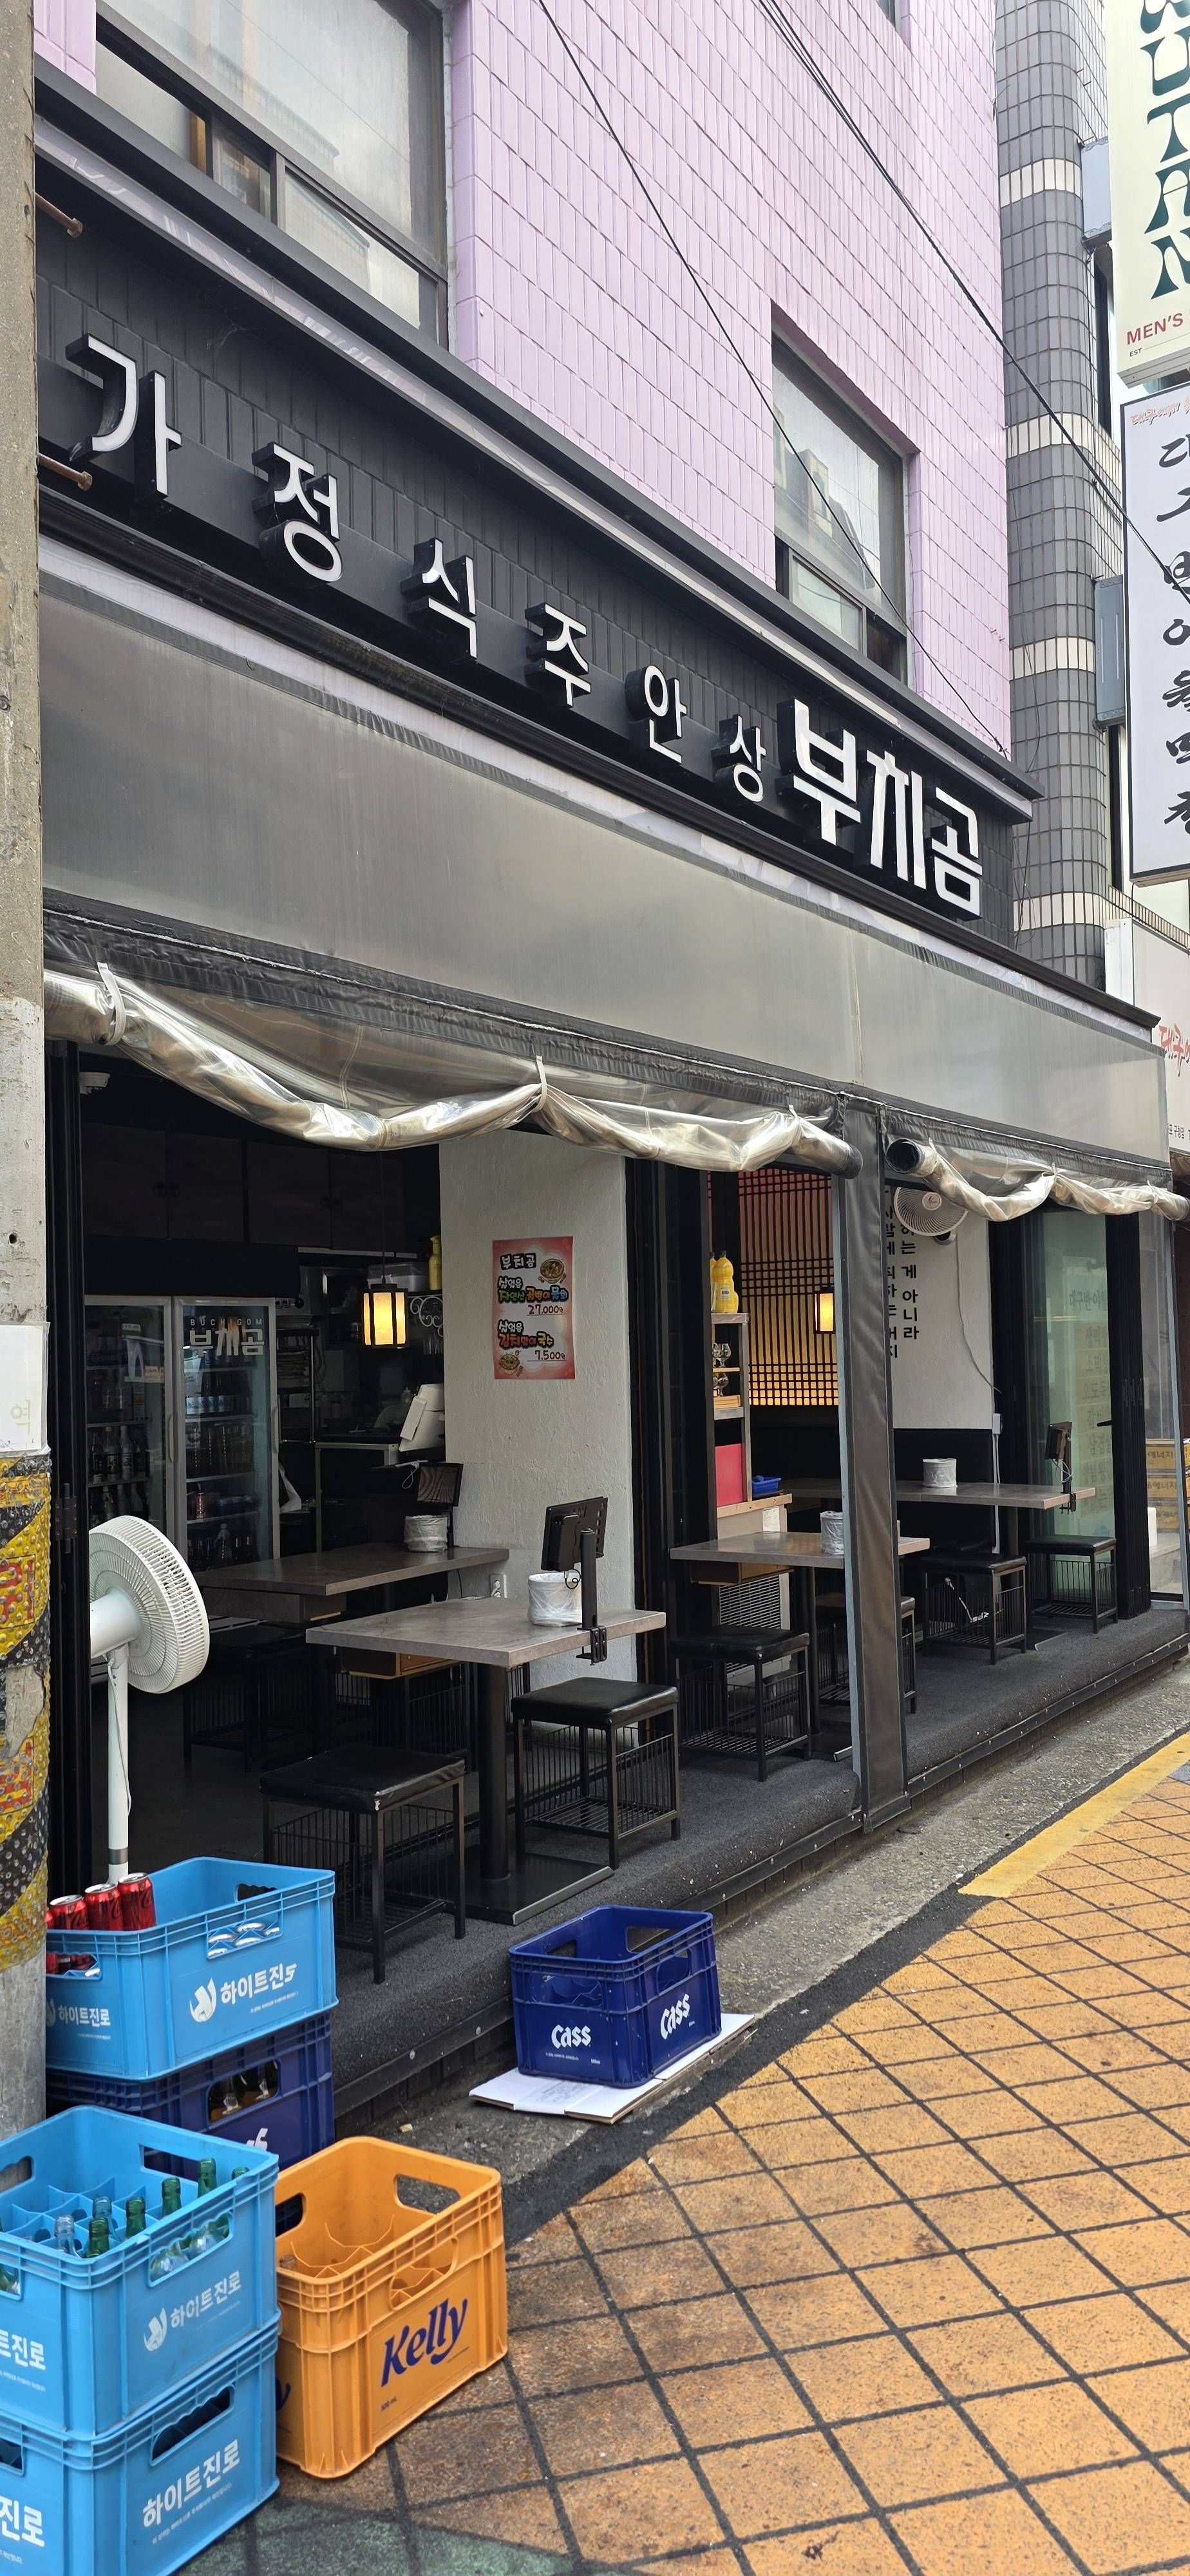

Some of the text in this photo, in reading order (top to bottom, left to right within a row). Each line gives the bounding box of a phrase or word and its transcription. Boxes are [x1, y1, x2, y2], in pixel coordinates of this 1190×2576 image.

[1127, 313, 1184, 345] MEN'S
[1129, 348, 1142, 357] EST
[190, 1318, 263, 1327] BUCHIGOM
[902, 1289, 920, 1340] 아니라
[58, 2004, 111, 2028] 하이트진로
[660, 1993, 690, 2040] Cass
[551, 2024, 592, 2049] Cass
[170, 2270, 242, 2329] 하이트진로
[381, 2298, 469, 2388] Kelly
[143, 2439, 240, 2528] 하이트진로
